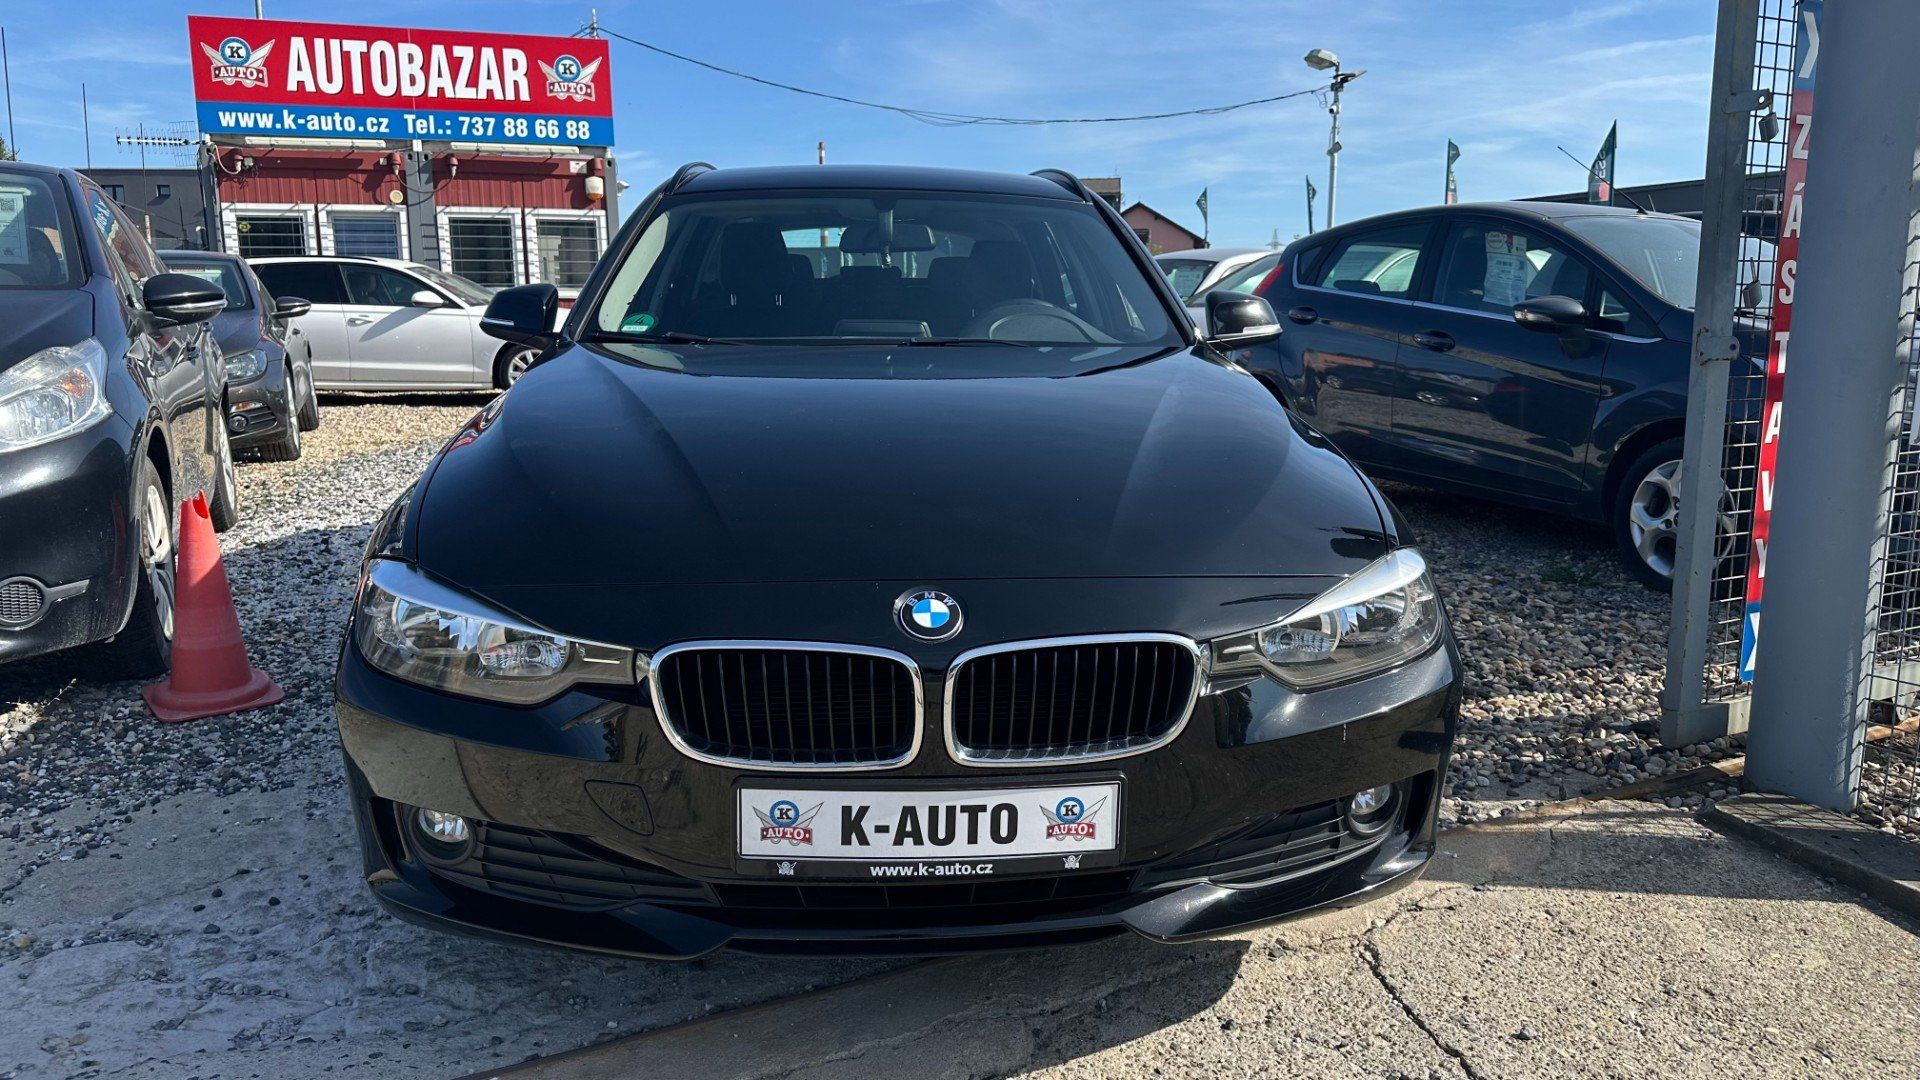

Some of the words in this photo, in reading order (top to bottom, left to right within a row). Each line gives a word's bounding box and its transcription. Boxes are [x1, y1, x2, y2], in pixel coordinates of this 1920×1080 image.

[227, 46, 244, 59] K
[218, 66, 258, 80] AUTO
[286, 36, 531, 101] AUTOBAZAR
[560, 63, 575, 75] K
[552, 82, 587, 94] AUTO
[218, 109, 390, 133] www.k-auto.cz
[403, 113, 452, 135] Tel.:
[458, 116, 496, 136] 737
[503, 117, 528, 138] 88
[535, 119, 560, 138] 66
[566, 120, 590, 140] 88
[906, 591, 956, 606] BMW
[776, 807, 793, 820] K
[1062, 804, 1078, 817] K
[840, 802, 1019, 847] K-AUTO
[1052, 823, 1088, 835] AUTO
[766, 827, 805, 840] AUTO
[869, 862, 994, 877] www.k-auto.cz
